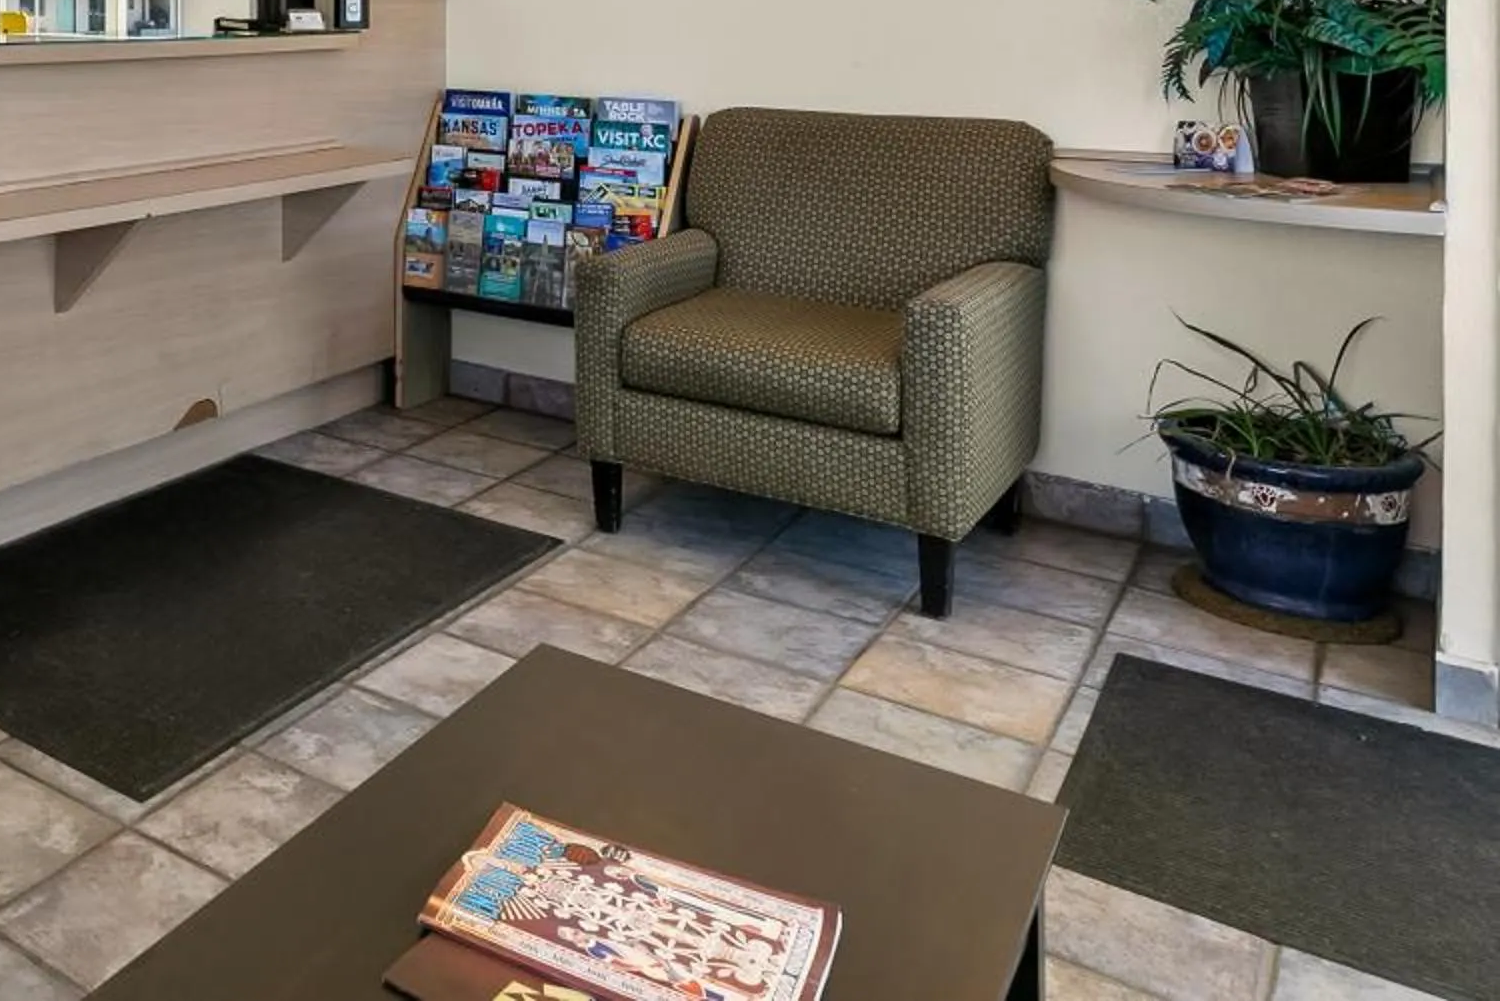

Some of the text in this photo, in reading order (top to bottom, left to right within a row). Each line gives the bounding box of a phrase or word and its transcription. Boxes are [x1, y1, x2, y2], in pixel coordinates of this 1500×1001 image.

[603, 100, 645, 112] TABLE
[443, 119, 497, 136] KANSAS
[510, 120, 583, 138] TOPEKA
[598, 129, 665, 148] VISIT KC
